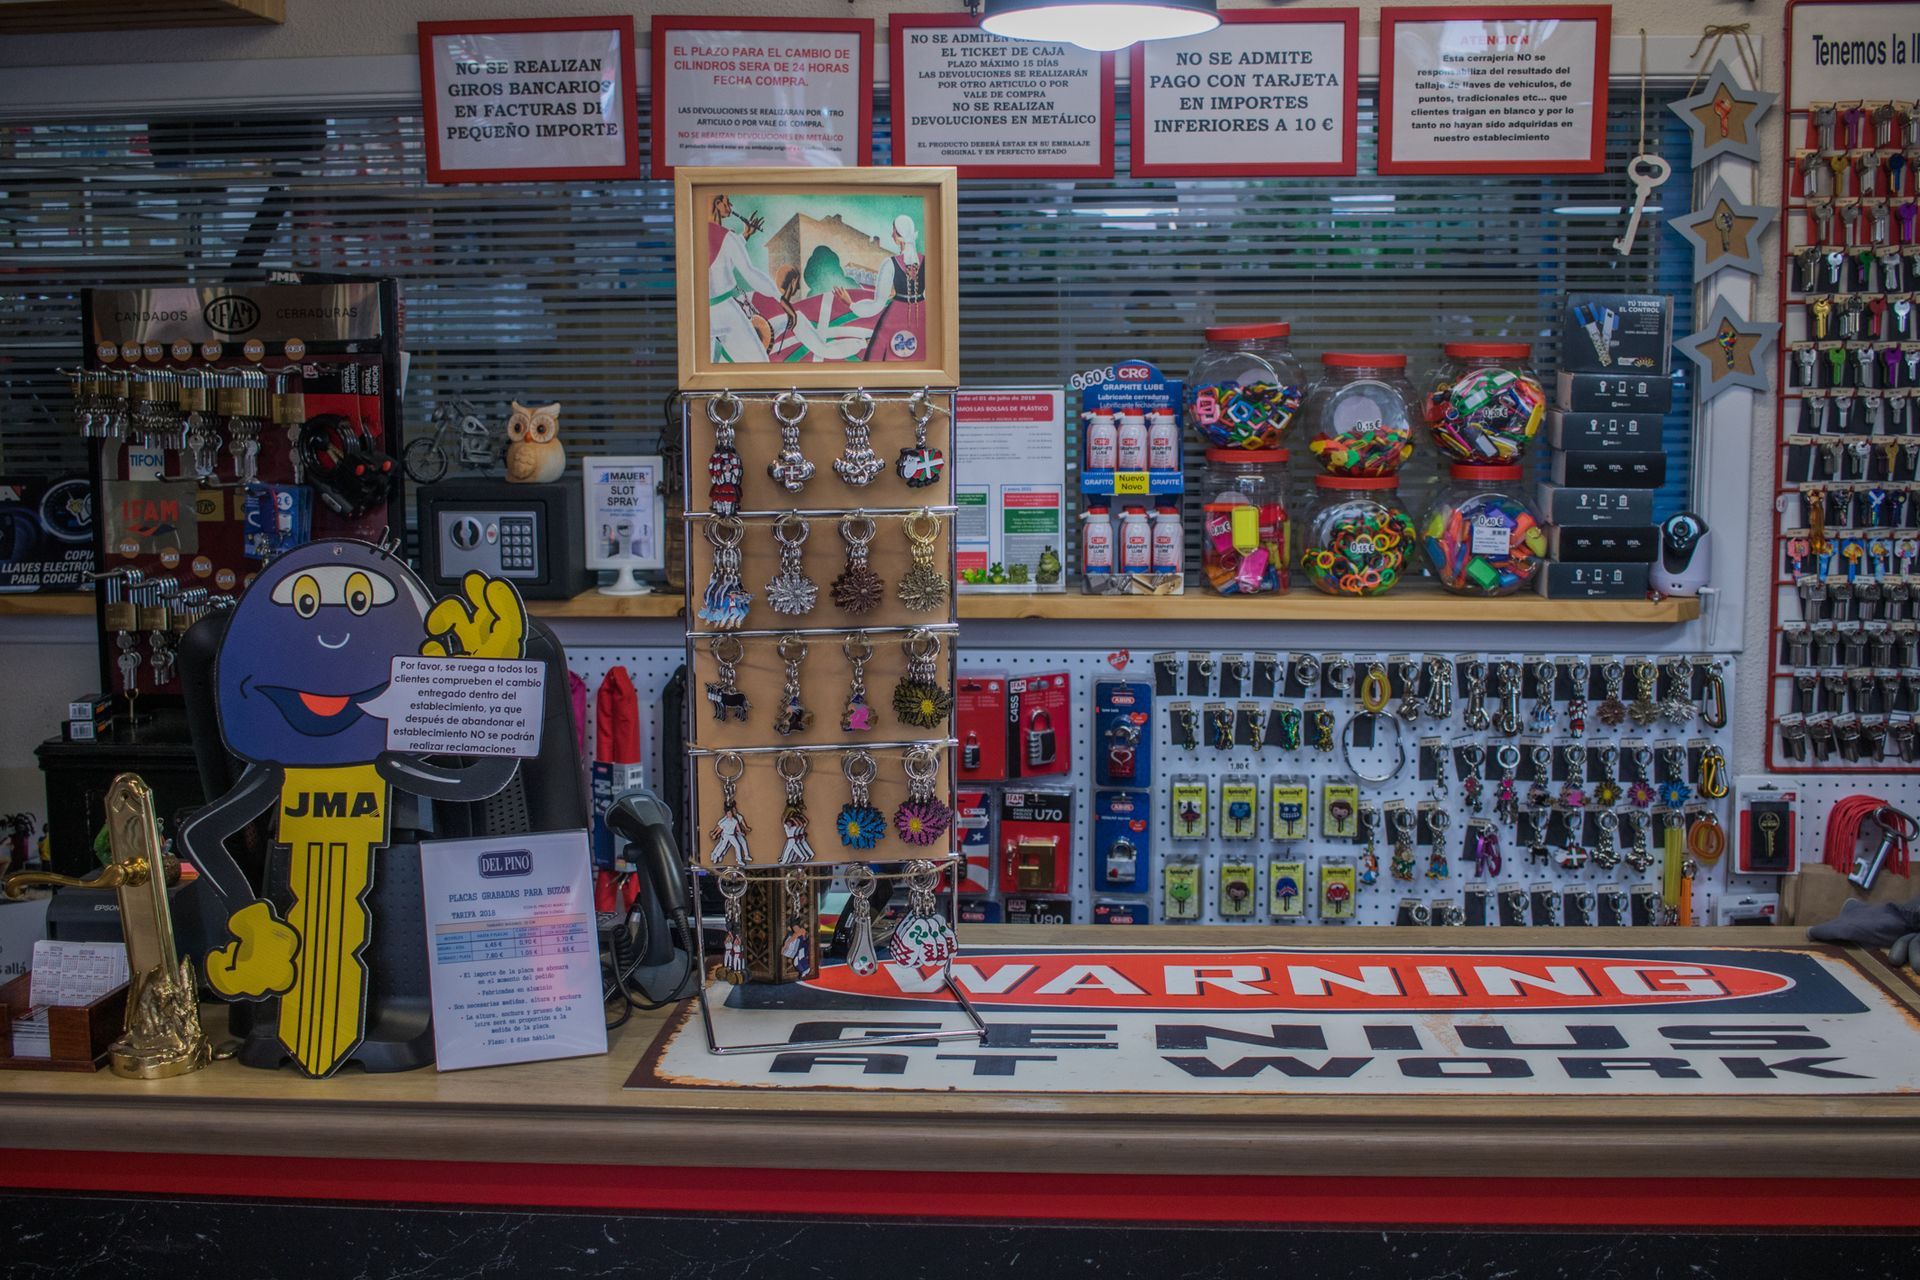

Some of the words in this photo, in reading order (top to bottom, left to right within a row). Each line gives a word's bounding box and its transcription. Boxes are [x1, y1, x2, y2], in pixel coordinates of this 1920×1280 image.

[911, 34, 929, 44] NO
[932, 34, 948, 44] SE
[952, 34, 1008, 44] ADMITEN
[673, 46, 688, 56] EL
[691, 46, 730, 57] PLAZO
[732, 47, 764, 57] PARA
[768, 47, 782, 58] EL
[785, 48, 832, 59] CAMBIO
[834, 49, 850, 59] DE
[941, 47, 957, 57] EL
[960, 47, 1008, 57] TICKET
[1011, 47, 1029, 56] DE
[1032, 46, 1065, 56] CAJA
[1812, 35, 1886, 66] Tenemos
[1892, 33, 1906, 64] la
[980, 58, 1020, 67] MÁXIMO
[1036, 58, 1059, 67] DÍAS
[1176, 52, 1203, 66] NO
[1209, 52, 1233, 65] SE
[1238, 51, 1313, 65] ADMITE
[1443, 54, 1464, 62] Esta
[1467, 54, 1514, 64] cerrajería
[1517, 53, 1532, 61] NO
[456, 62, 480, 75] NO
[486, 62, 508, 74] SE
[514, 59, 602, 74] REALIZAN
[674, 60, 736, 71] CILINDROS
[739, 61, 770, 71] SERA
[774, 62, 789, 72] DE
[792, 62, 805, 72] 24
[808, 63, 849, 73] HORAS
[1417, 68, 1487, 77] responsbiliza
[1507, 67, 1553, 75] resultado
[713, 75, 753, 85] FECHA
[755, 76, 809, 87] COMPRA.
[1150, 74, 1201, 88] PAGO
[1207, 74, 1246, 88] CON
[1252, 73, 1339, 87] TARJETA
[448, 83, 503, 97] GIROS
[509, 80, 612, 96] BANCARIOS
[952, 102, 970, 111] NO
[974, 102, 989, 111] SE
[993, 101, 1054, 111] REALIZAN
[1179, 97, 1204, 110] EN
[1211, 96, 1308, 110] IMPORTES
[1418, 95, 1454, 104] puntos,
[454, 104, 477, 118] EN
[483, 102, 577, 117] FACTURAS
[911, 115, 1007, 126] DEVOLUCIONES
[1011, 115, 1028, 125] EN
[1032, 112, 1096, 124] METÁLICO
[1154, 118, 1269, 133] INFERIORES
[1275, 118, 1288, 131] A
[1296, 118, 1316, 131] 10
[1322, 118, 1333, 131] €
[446, 122, 530, 142] PEQUEÑO
[536, 123, 618, 137] IMPORTE
[1472, 133, 1550, 142] establecimiento
[268, 271, 300, 284] JMA
[115, 311, 188, 322] CANDADOS
[276, 307, 358, 320] CERRADURAS
[1072, 370, 1102, 388] 6,60
[1105, 368, 1114, 380] €
[1118, 368, 1149, 378] CRC
[130, 454, 164, 467] TIFON
[610, 472, 646, 480] MAUER
[610, 486, 635, 495] SLOT
[608, 497, 638, 506] SPRAY
[121, 500, 178, 522] IFAM
[2, 562, 41, 574] LLAVES
[11, 574, 40, 585] PARA
[42, 573, 78, 584] COCHE
[400, 661, 415, 670] Por
[417, 661, 443, 671] favor,
[458, 665, 486, 674] ruega
[497, 664, 523, 674] todos
[525, 665, 538, 674] los
[394, 674, 430, 684] clientes
[432, 677, 492, 686] comprueben
[494, 678, 504, 686] el
[505, 678, 542, 688] cambio
[418, 689, 467, 700] entregado
[468, 690, 499, 699] dentro
[501, 691, 517, 700] del
[410, 701, 487, 713] establecimiento,
[489, 706, 501, 715] ya
[504, 706, 522, 715] que
[405, 714, 444, 725] después
[446, 716, 459, 725] de
[461, 717, 514, 727] abandonar
[516, 718, 525, 727] el
[393, 727, 468, 738] establecimiento
[470, 730, 486, 739] NO
[500, 731, 535, 742] podrán
[410, 741, 444, 751] realizar
[446, 742, 516, 754] reclamaciones
[285, 792, 380, 818] JMA
[1034, 809, 1063, 821] U70
[482, 857, 503, 872] DEL
[504, 854, 530, 871] PINO
[448, 892, 478, 902] PLACAS
[482, 890, 520, 900] GRABADAS
[524, 888, 543, 897] PARA
[547, 885, 571, 895] BUZÓN
[451, 910, 476, 920] TARIFA
[1034, 914, 1064, 924] U90
[8, 960, 28, 975] allá
[884, 964, 1729, 996] WARNING
[789, 1022, 1830, 1051] GENIUS
[769, 1053, 1057, 1075] AT
[1161, 1056, 1877, 1079] WORK
